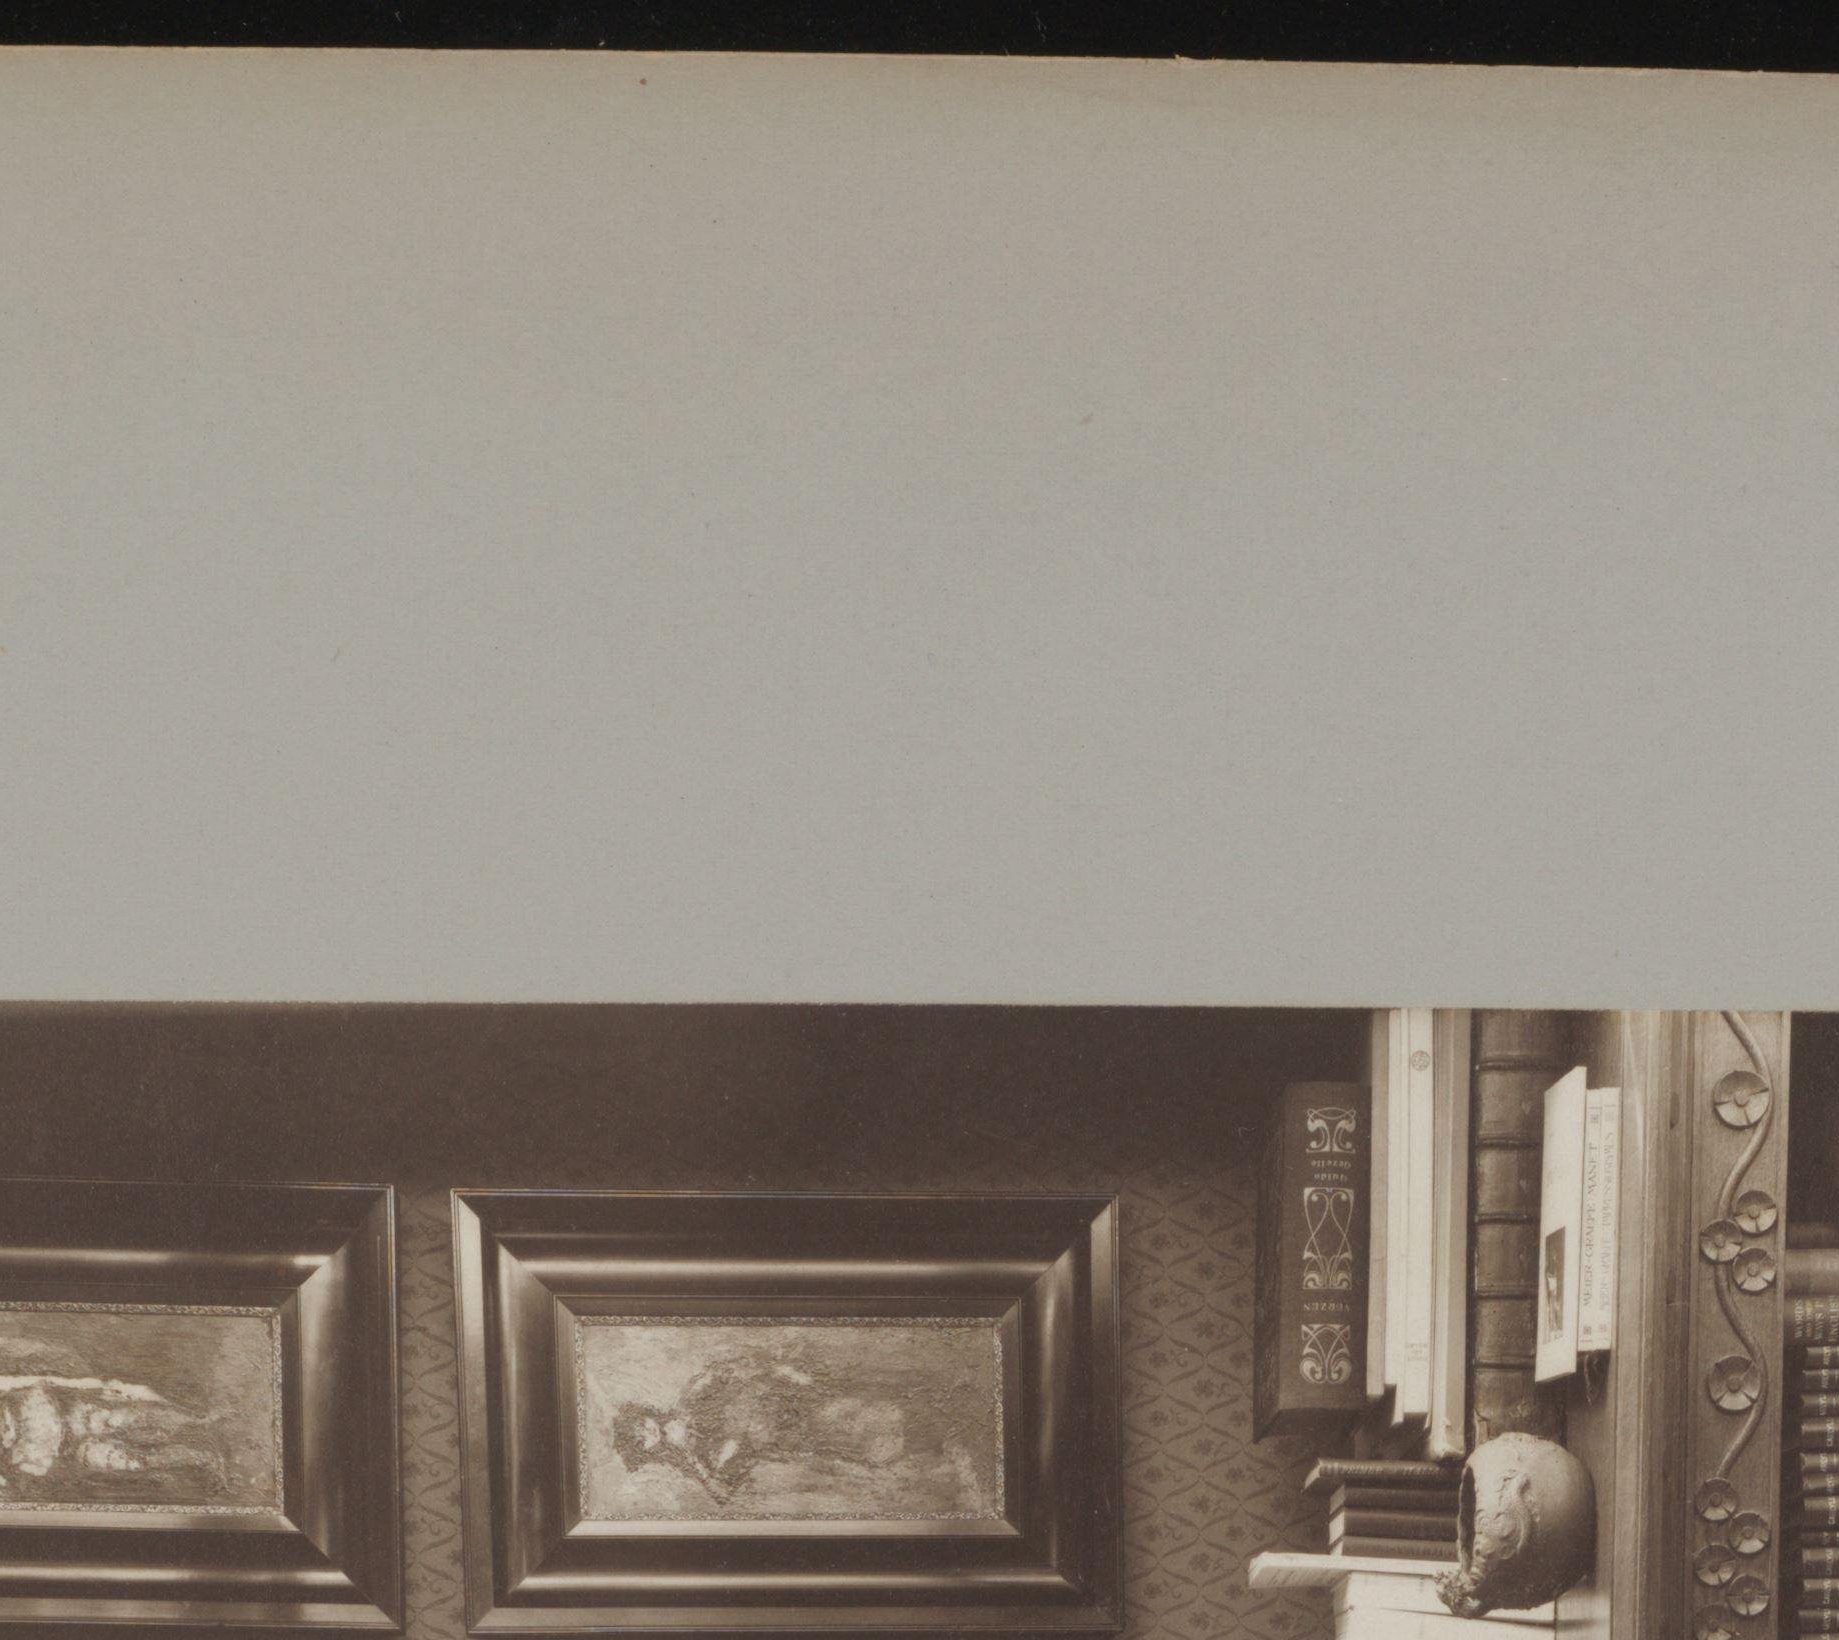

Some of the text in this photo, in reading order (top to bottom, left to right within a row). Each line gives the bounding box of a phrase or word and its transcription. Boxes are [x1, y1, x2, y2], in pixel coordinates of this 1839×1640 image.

[1313, 1172, 1349, 1182] Guido
[1583, 1141, 1598, 1308] MEIER-GRAEFE MANET
[1303, 1301, 1350, 1312] VERZEN
[1794, 1299, 1803, 1338] WORDS
[1814, 1312, 1824, 1340] WAYS
[1828, 1296, 1839, 1342] ENGLISH
[1822, 1347, 1831, 1365] ARLYL
[1820, 1369, 1829, 1388] ARLY
[1818, 1394, 1827, 1416] ARLYL
[1825, 1418, 1834, 1446] CARLYLE
[1819, 1453, 1828, 1471] ARLYL
[1825, 1475, 1834, 1493] ARLYL
[1827, 1497, 1836, 1525] CARLYLE
[1823, 1579, 1831, 1604] CARLYL
[1823, 1609, 1831, 1630] ARLYL
